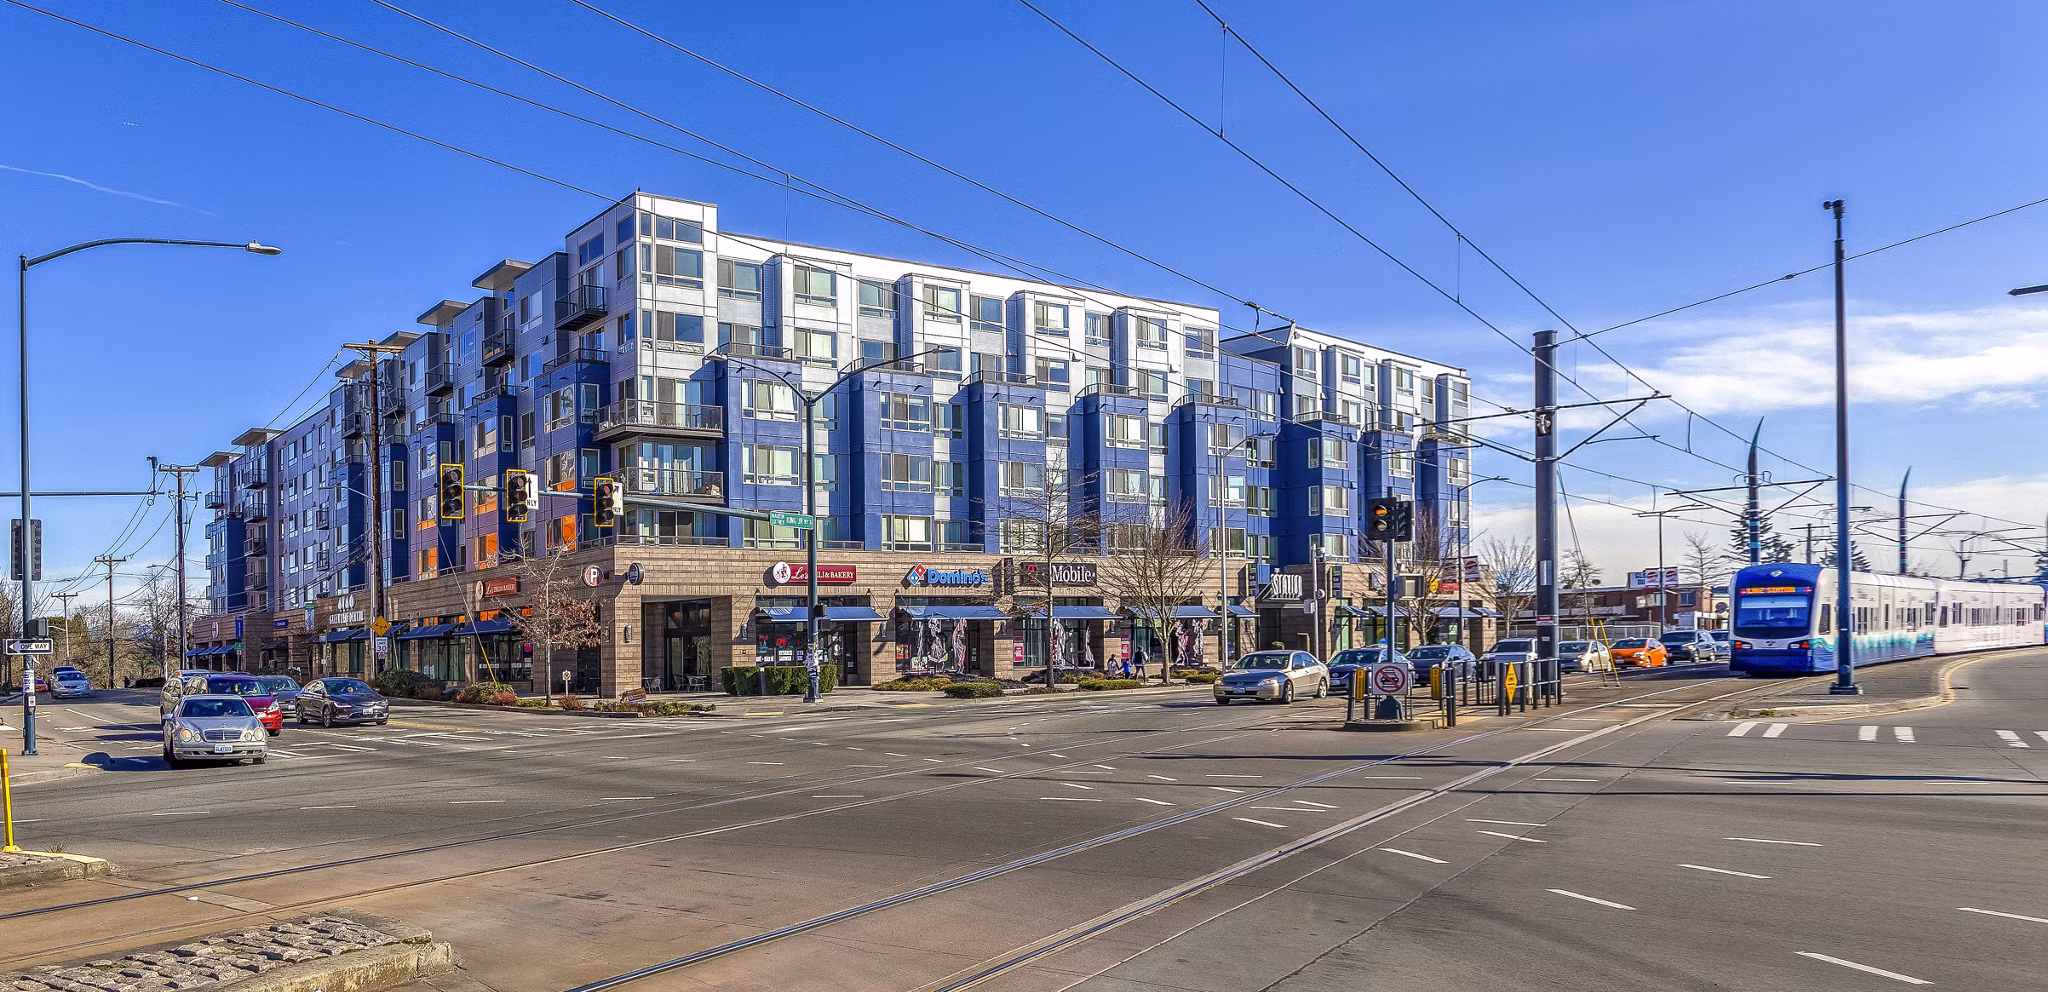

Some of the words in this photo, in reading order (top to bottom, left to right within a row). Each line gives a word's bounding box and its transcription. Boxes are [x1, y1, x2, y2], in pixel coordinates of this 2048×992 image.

[786, 517, 797, 525] KING
[927, 567, 988, 584] Domino's
[1052, 565, 1092, 582] Mobile
